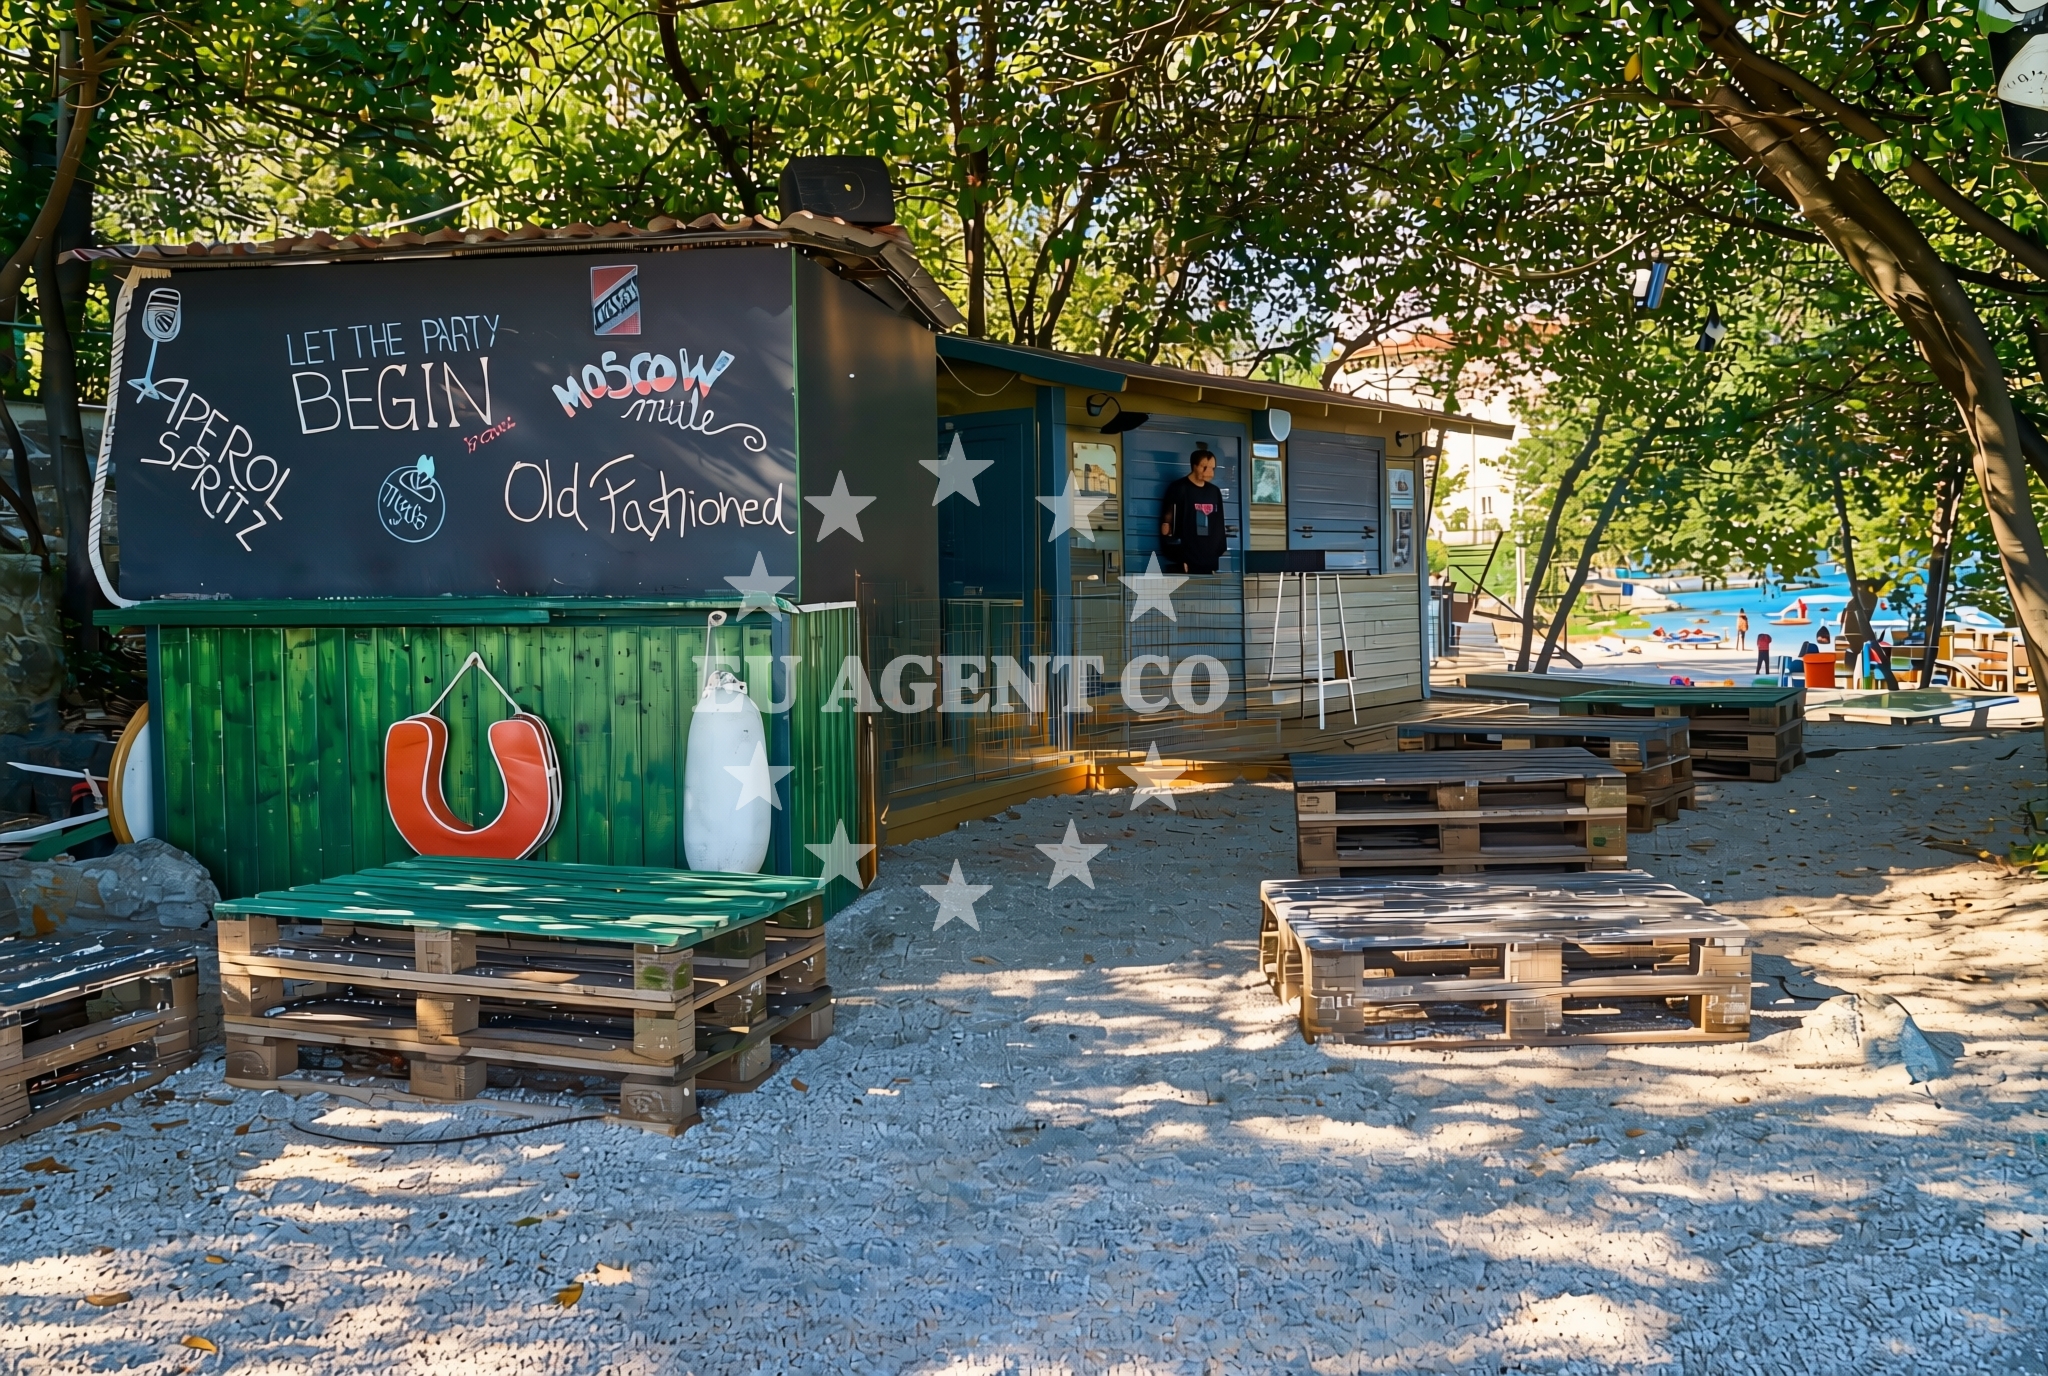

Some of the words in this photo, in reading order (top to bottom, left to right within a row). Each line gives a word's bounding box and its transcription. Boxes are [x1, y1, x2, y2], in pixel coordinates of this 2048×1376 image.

[287, 328, 338, 366] LET
[347, 322, 406, 359] THE
[420, 314, 500, 354] PARTY
[291, 356, 491, 435] BEGIN
[551, 347, 736, 418] MOSCOW
[136, 377, 291, 521] APEROL
[504, 458, 588, 532] Old
